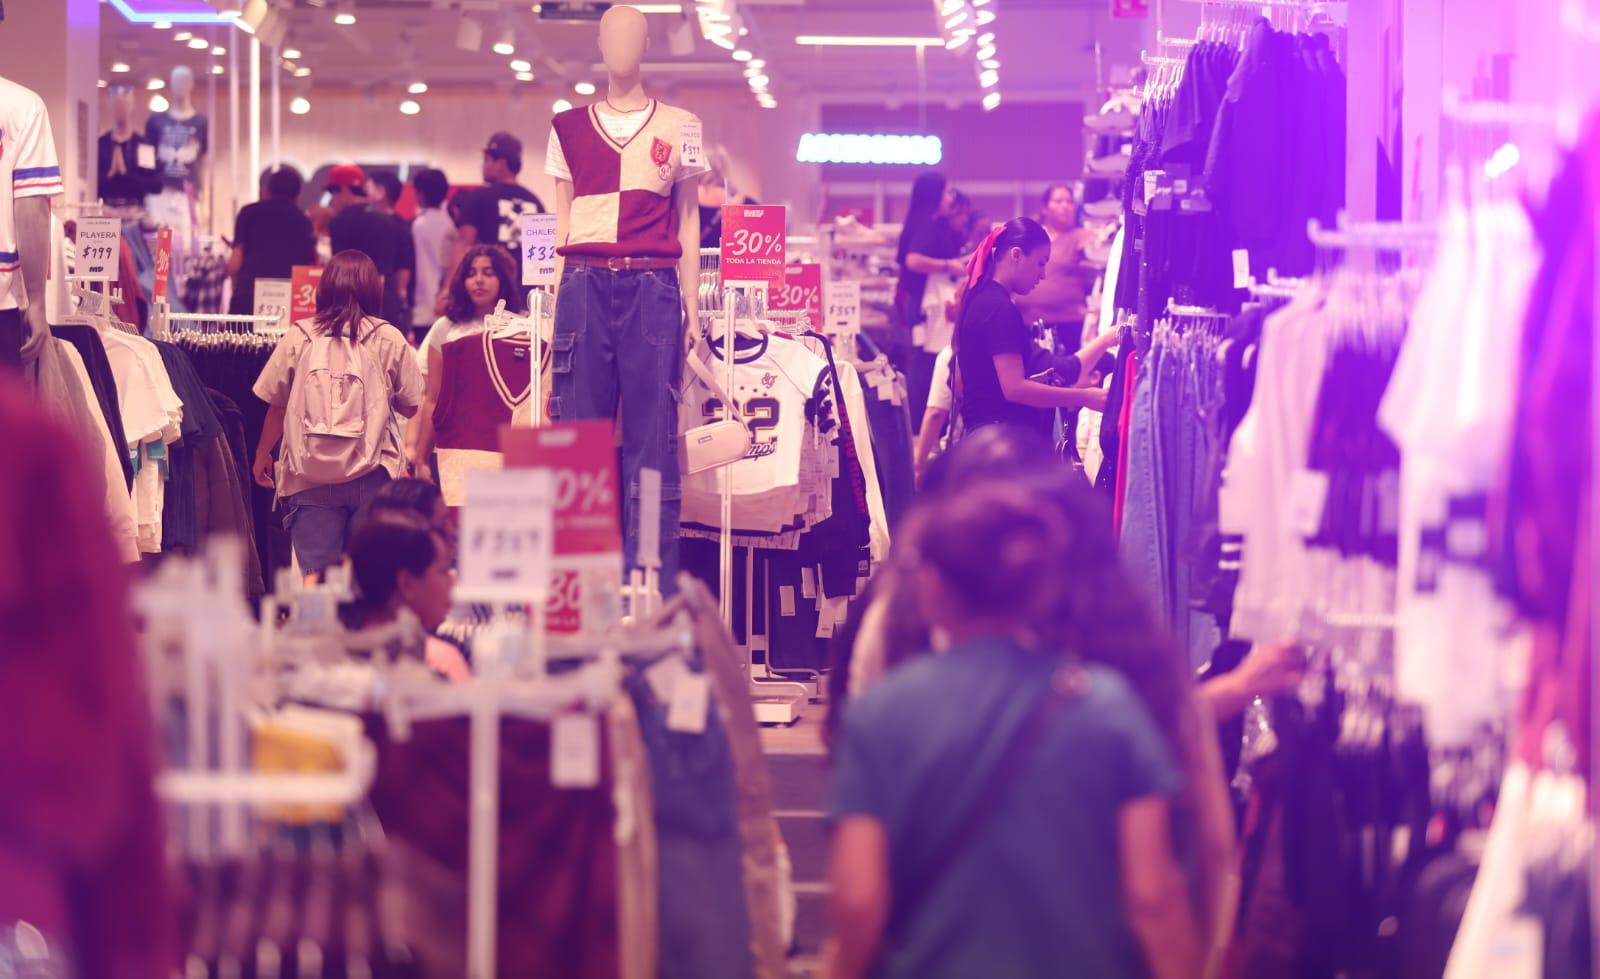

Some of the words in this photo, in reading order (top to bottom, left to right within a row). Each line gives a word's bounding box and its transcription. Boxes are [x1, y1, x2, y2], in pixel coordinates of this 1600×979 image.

[80, 231, 117, 239] PLAYERA
[526, 228, 556, 237] CHALEC
[725, 229, 782, 255] -30%
[527, 243, 555, 261] $32
[725, 257, 745, 265] TODA
[770, 284, 819, 308] -30%
